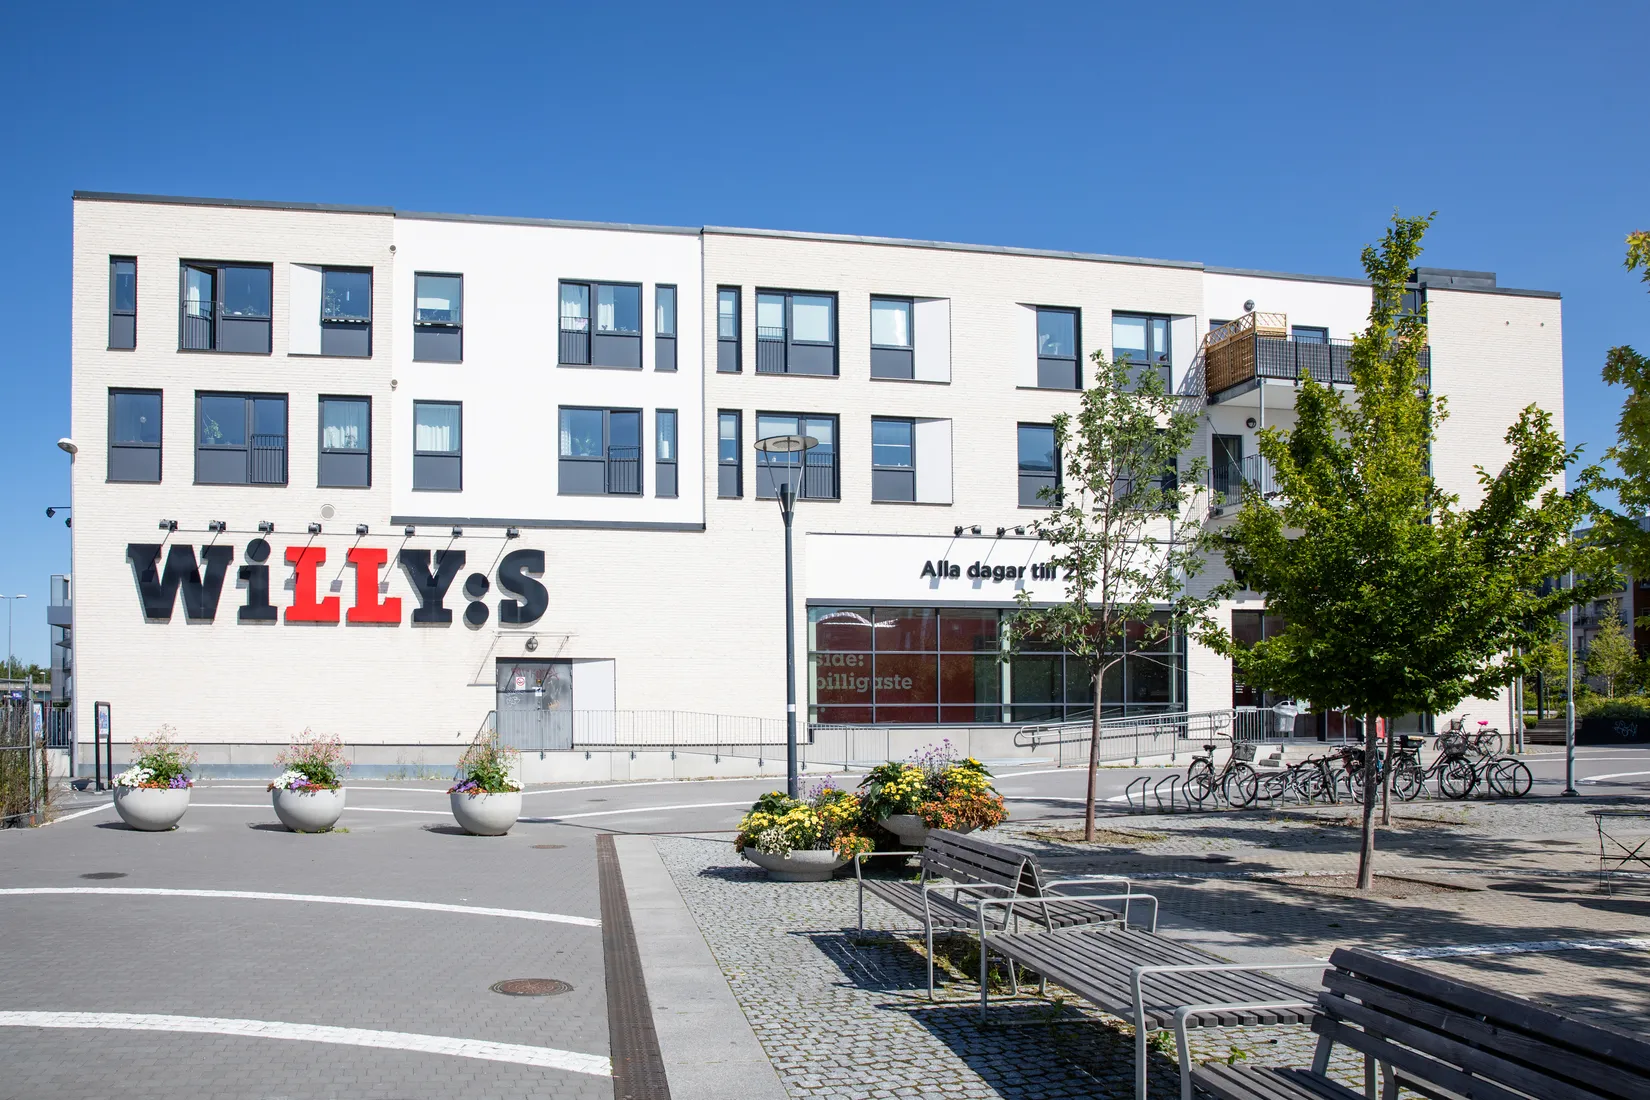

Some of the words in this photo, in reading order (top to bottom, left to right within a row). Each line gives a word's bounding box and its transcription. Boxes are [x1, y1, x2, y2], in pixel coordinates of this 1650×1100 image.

[921, 559, 961, 578] Alla
[967, 561, 1027, 582] dagar
[1031, 562, 1057, 579] till
